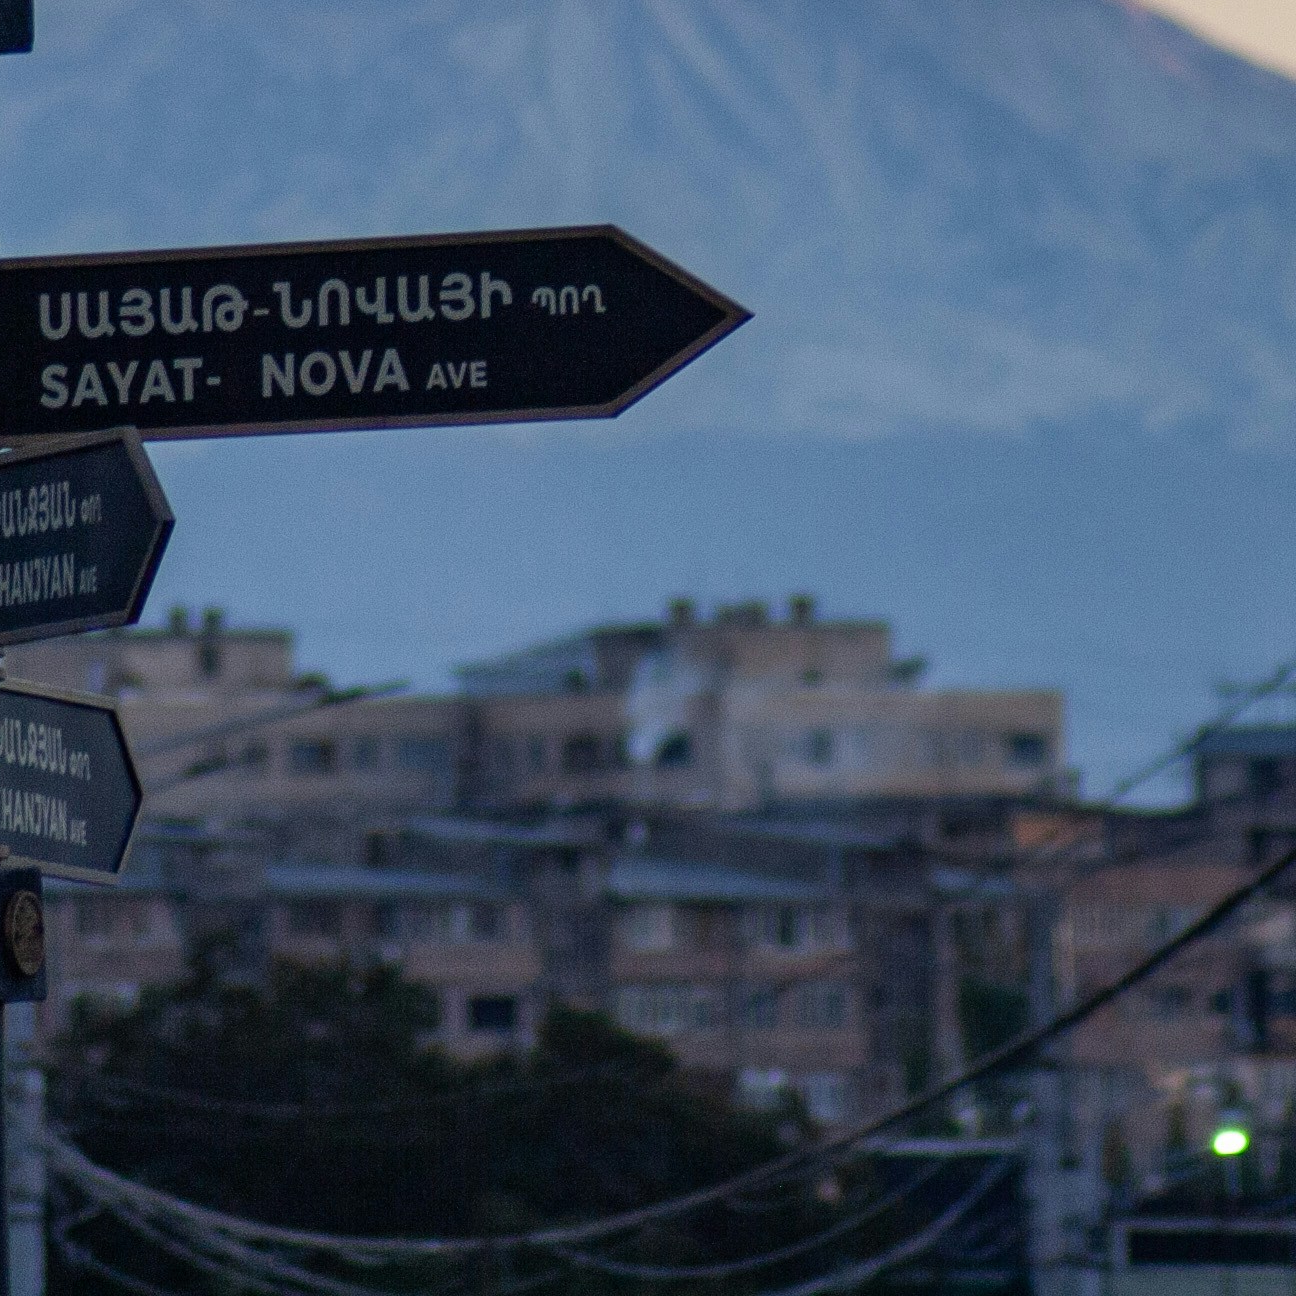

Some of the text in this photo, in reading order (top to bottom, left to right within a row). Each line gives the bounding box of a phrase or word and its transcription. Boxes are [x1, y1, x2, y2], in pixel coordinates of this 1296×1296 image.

[40, 272, 512, 340] ՍԱՅԱԹ-ՆՈՎԱՅԻ
[41, 349, 487, 408] SAYAT- NOVA AVE
[79, 566, 98, 593] AVE
[2, 789, 67, 840] HANJYAN
